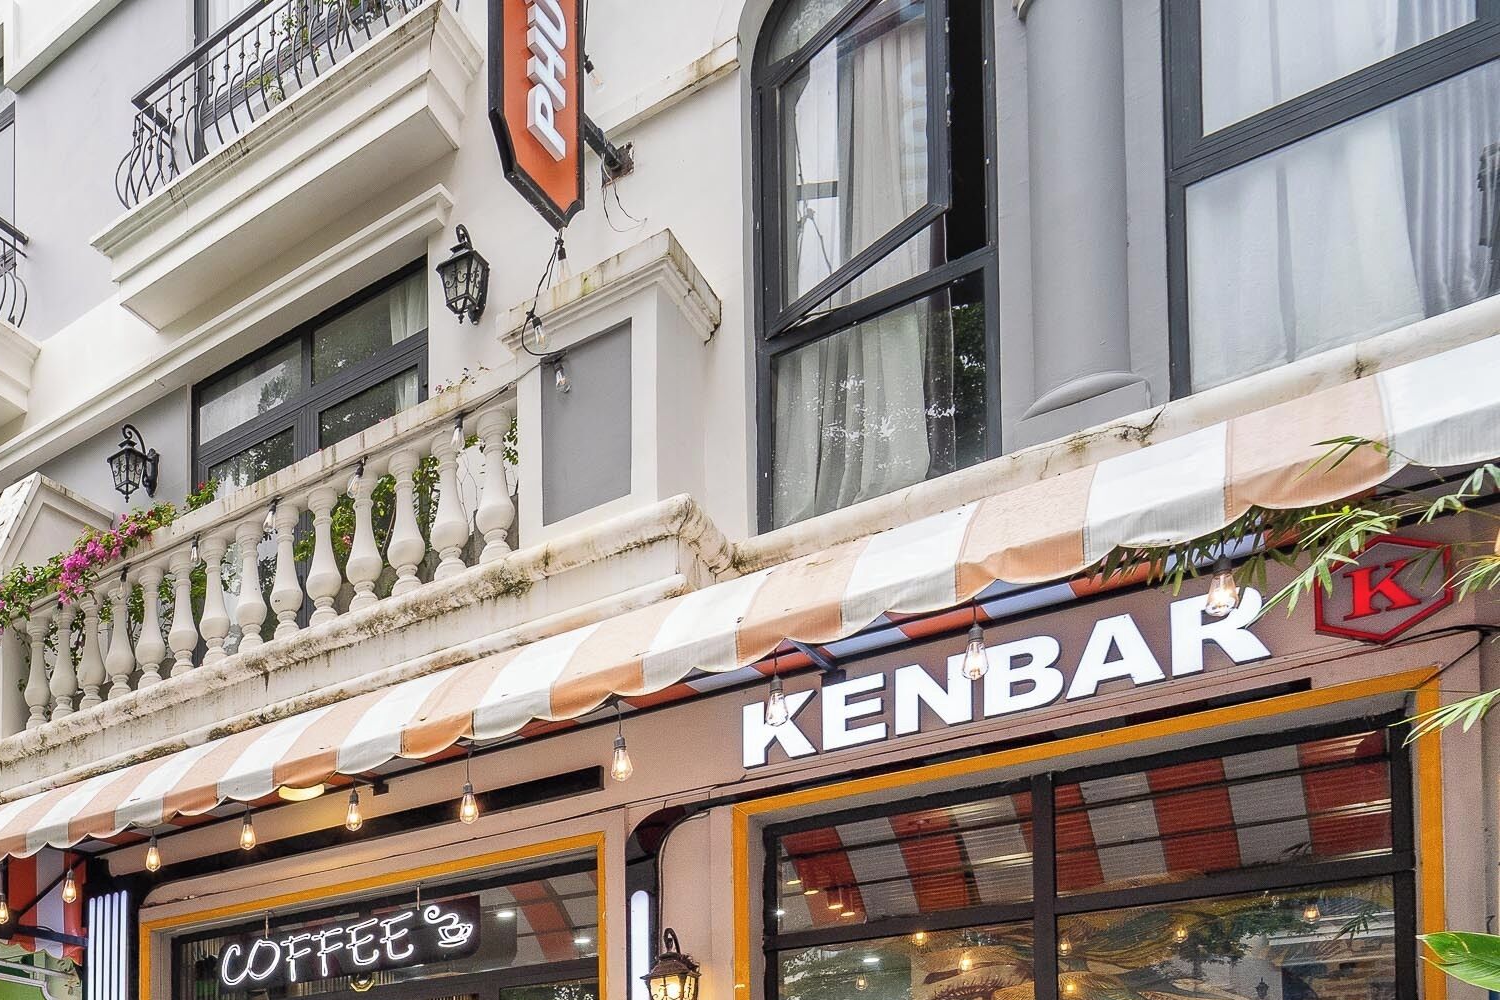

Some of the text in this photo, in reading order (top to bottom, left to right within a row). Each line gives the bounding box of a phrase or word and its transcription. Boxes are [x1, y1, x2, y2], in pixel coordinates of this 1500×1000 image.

[1343, 559, 1421, 621] K
[741, 586, 1273, 770] KENBAR
[220, 911, 414, 988] COFFEE
